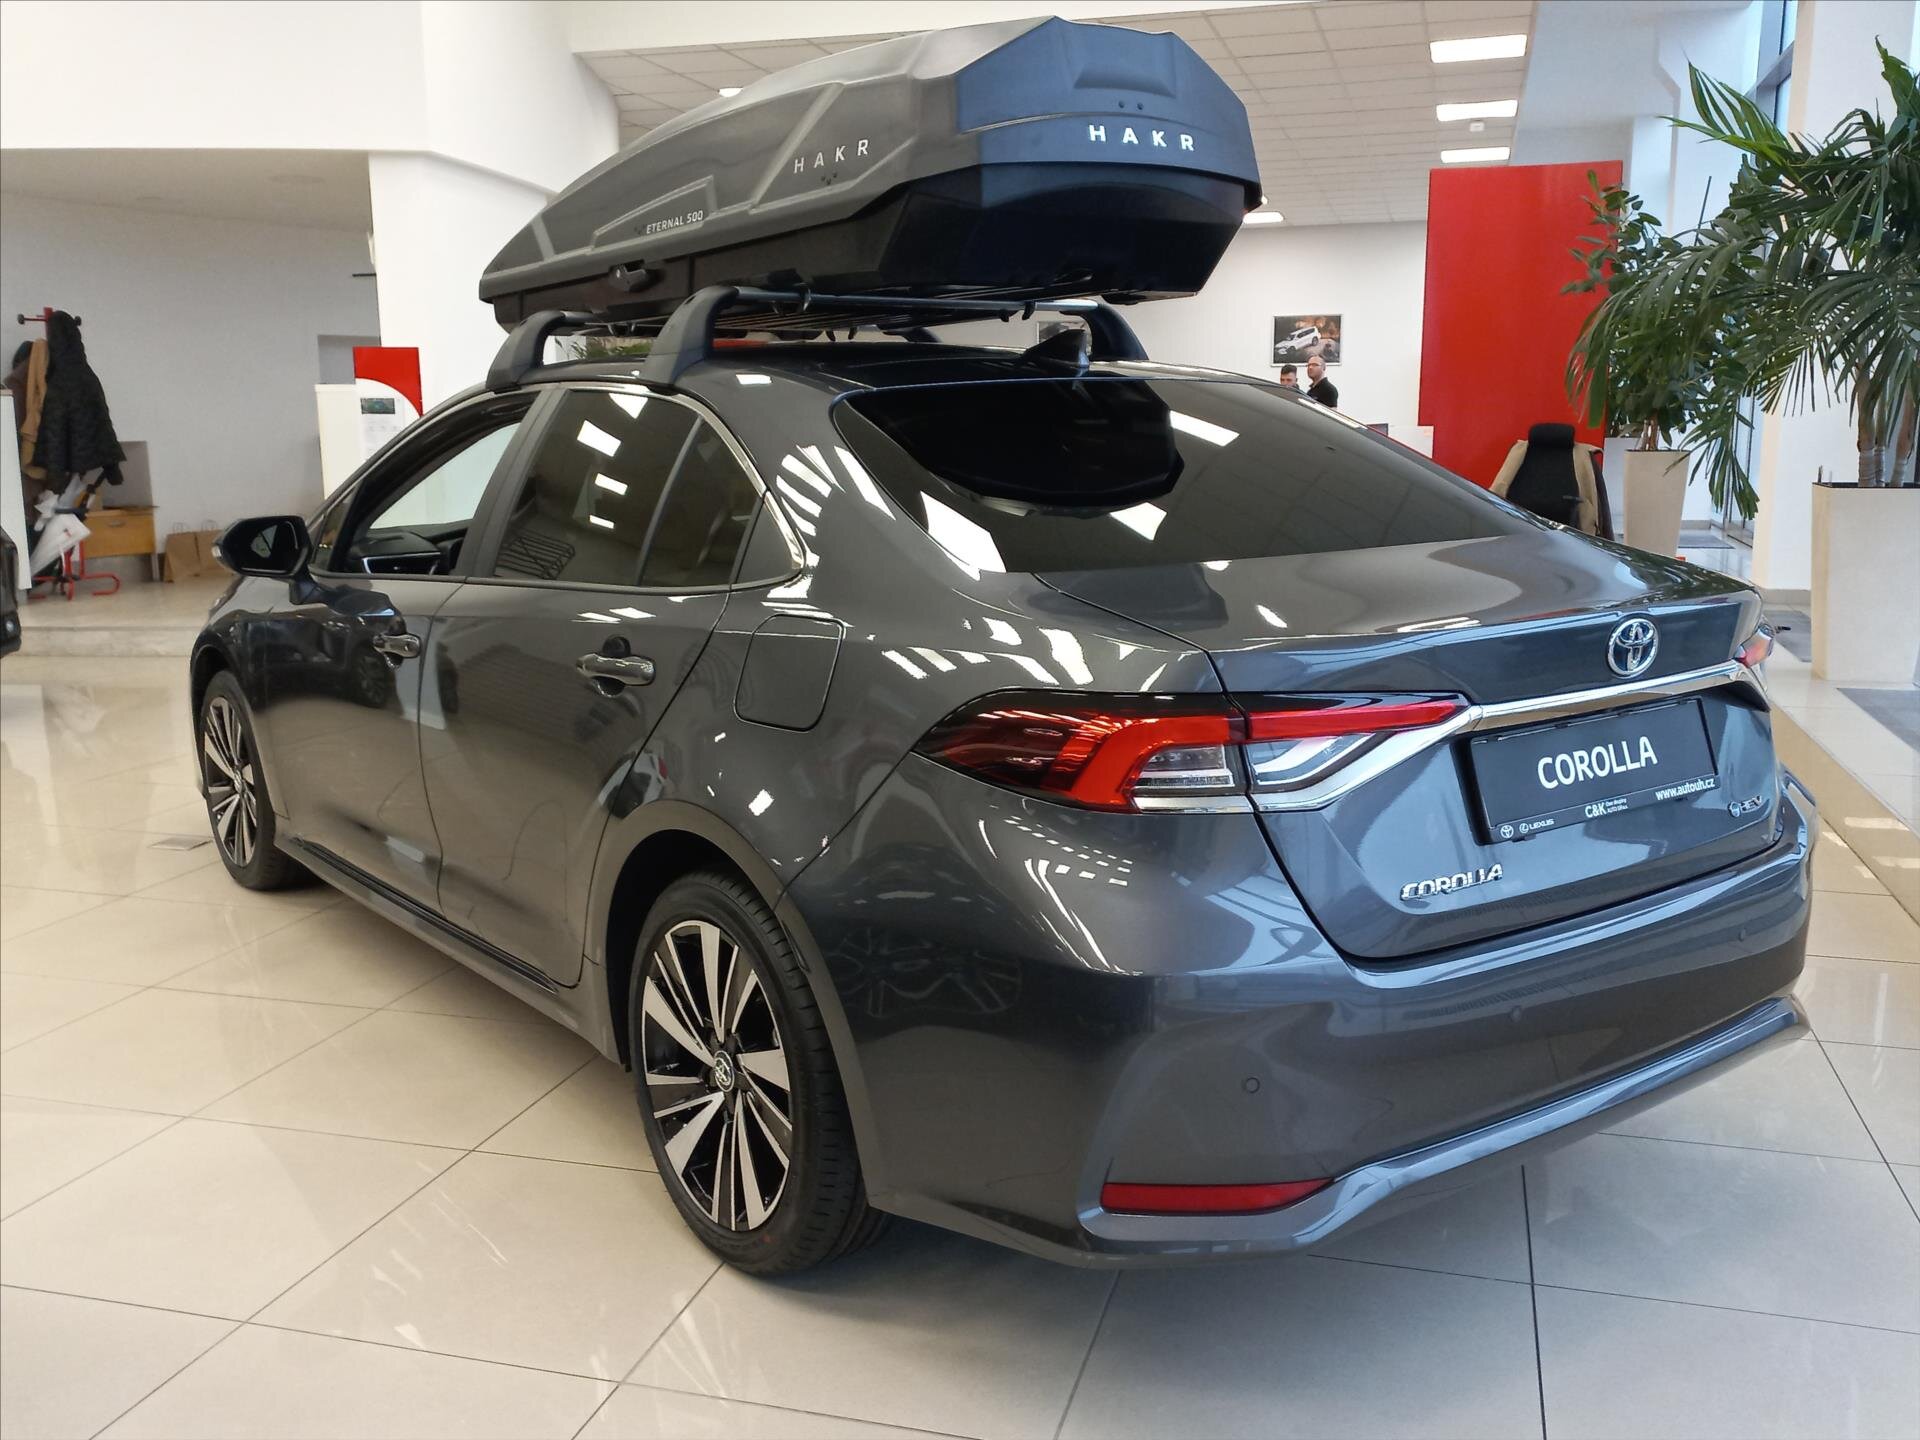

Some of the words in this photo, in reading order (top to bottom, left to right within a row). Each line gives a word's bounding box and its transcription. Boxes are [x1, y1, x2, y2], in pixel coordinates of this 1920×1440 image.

[1089, 124, 1195, 151] HAKR
[794, 139, 869, 174] HAKR
[646, 215, 685, 235] ETERNAL
[686, 209, 704, 224] 500
[1537, 735, 1659, 790] COROLLA
[1655, 778, 1716, 801] www.autouh.cz
[1584, 801, 1607, 819] C&K
[1529, 818, 1555, 830] LEXUS
[1401, 863, 1504, 900] COROLLA
